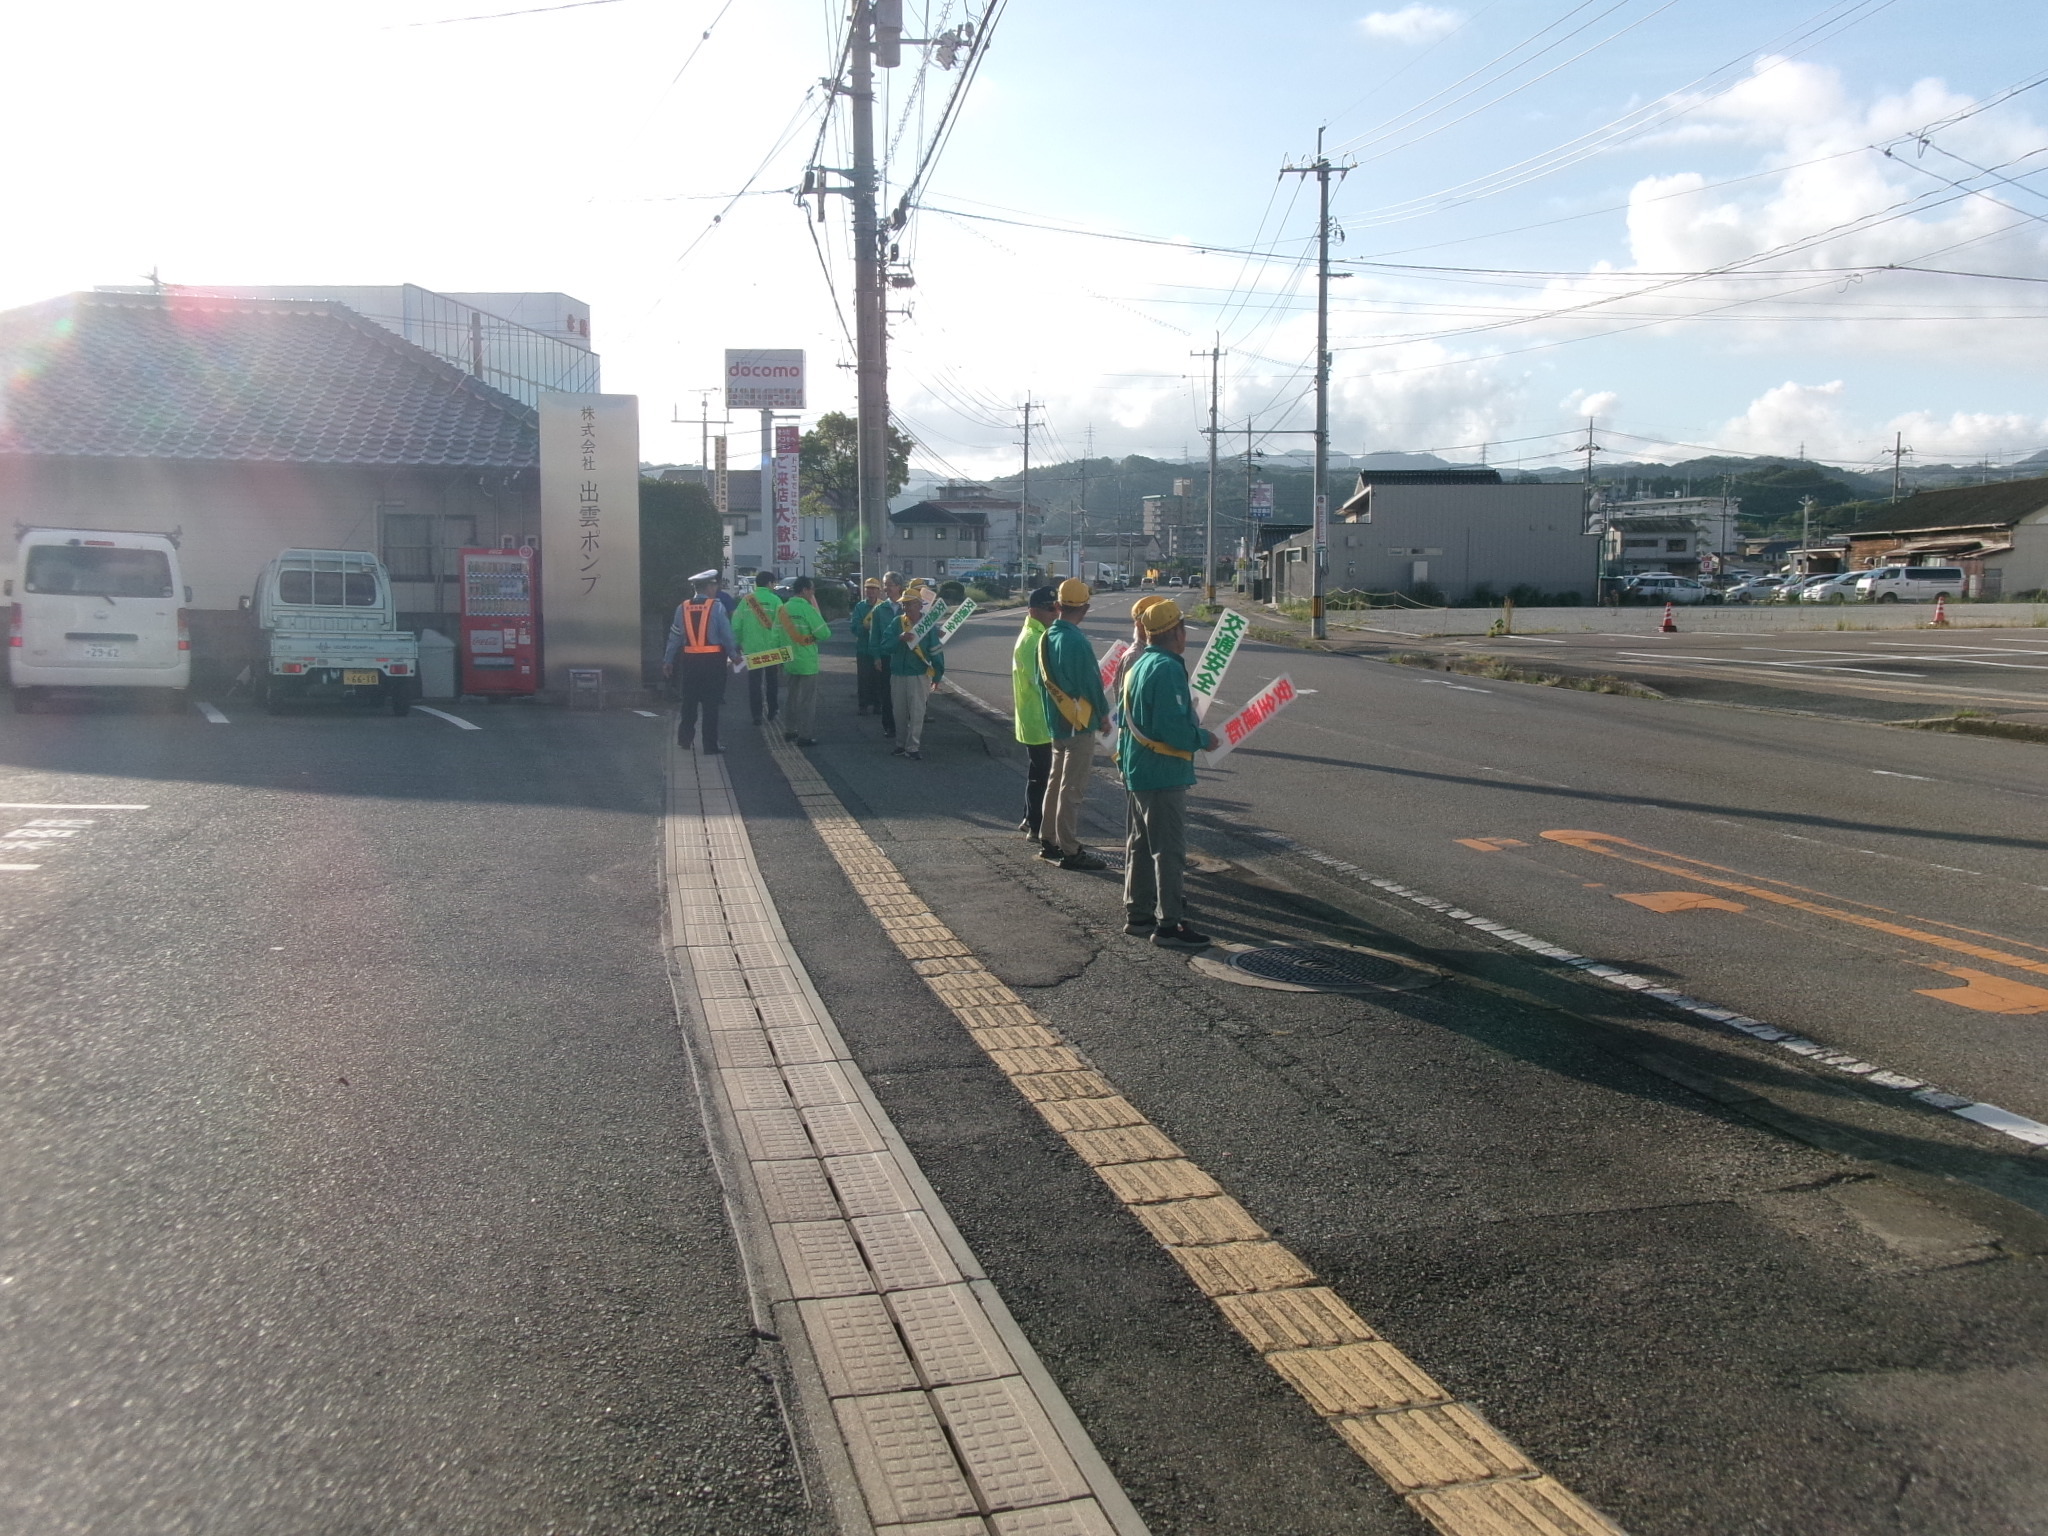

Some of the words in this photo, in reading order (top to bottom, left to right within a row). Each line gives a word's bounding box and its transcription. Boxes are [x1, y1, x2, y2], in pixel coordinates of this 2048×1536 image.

[729, 361, 799, 377] docomo
[580, 406, 596, 471] 株式会社
[579, 480, 601, 595] 出雲ポンプ
[1192, 613, 1246, 696] 交通安全
[1224, 677, 1294, 746] 安全運転
